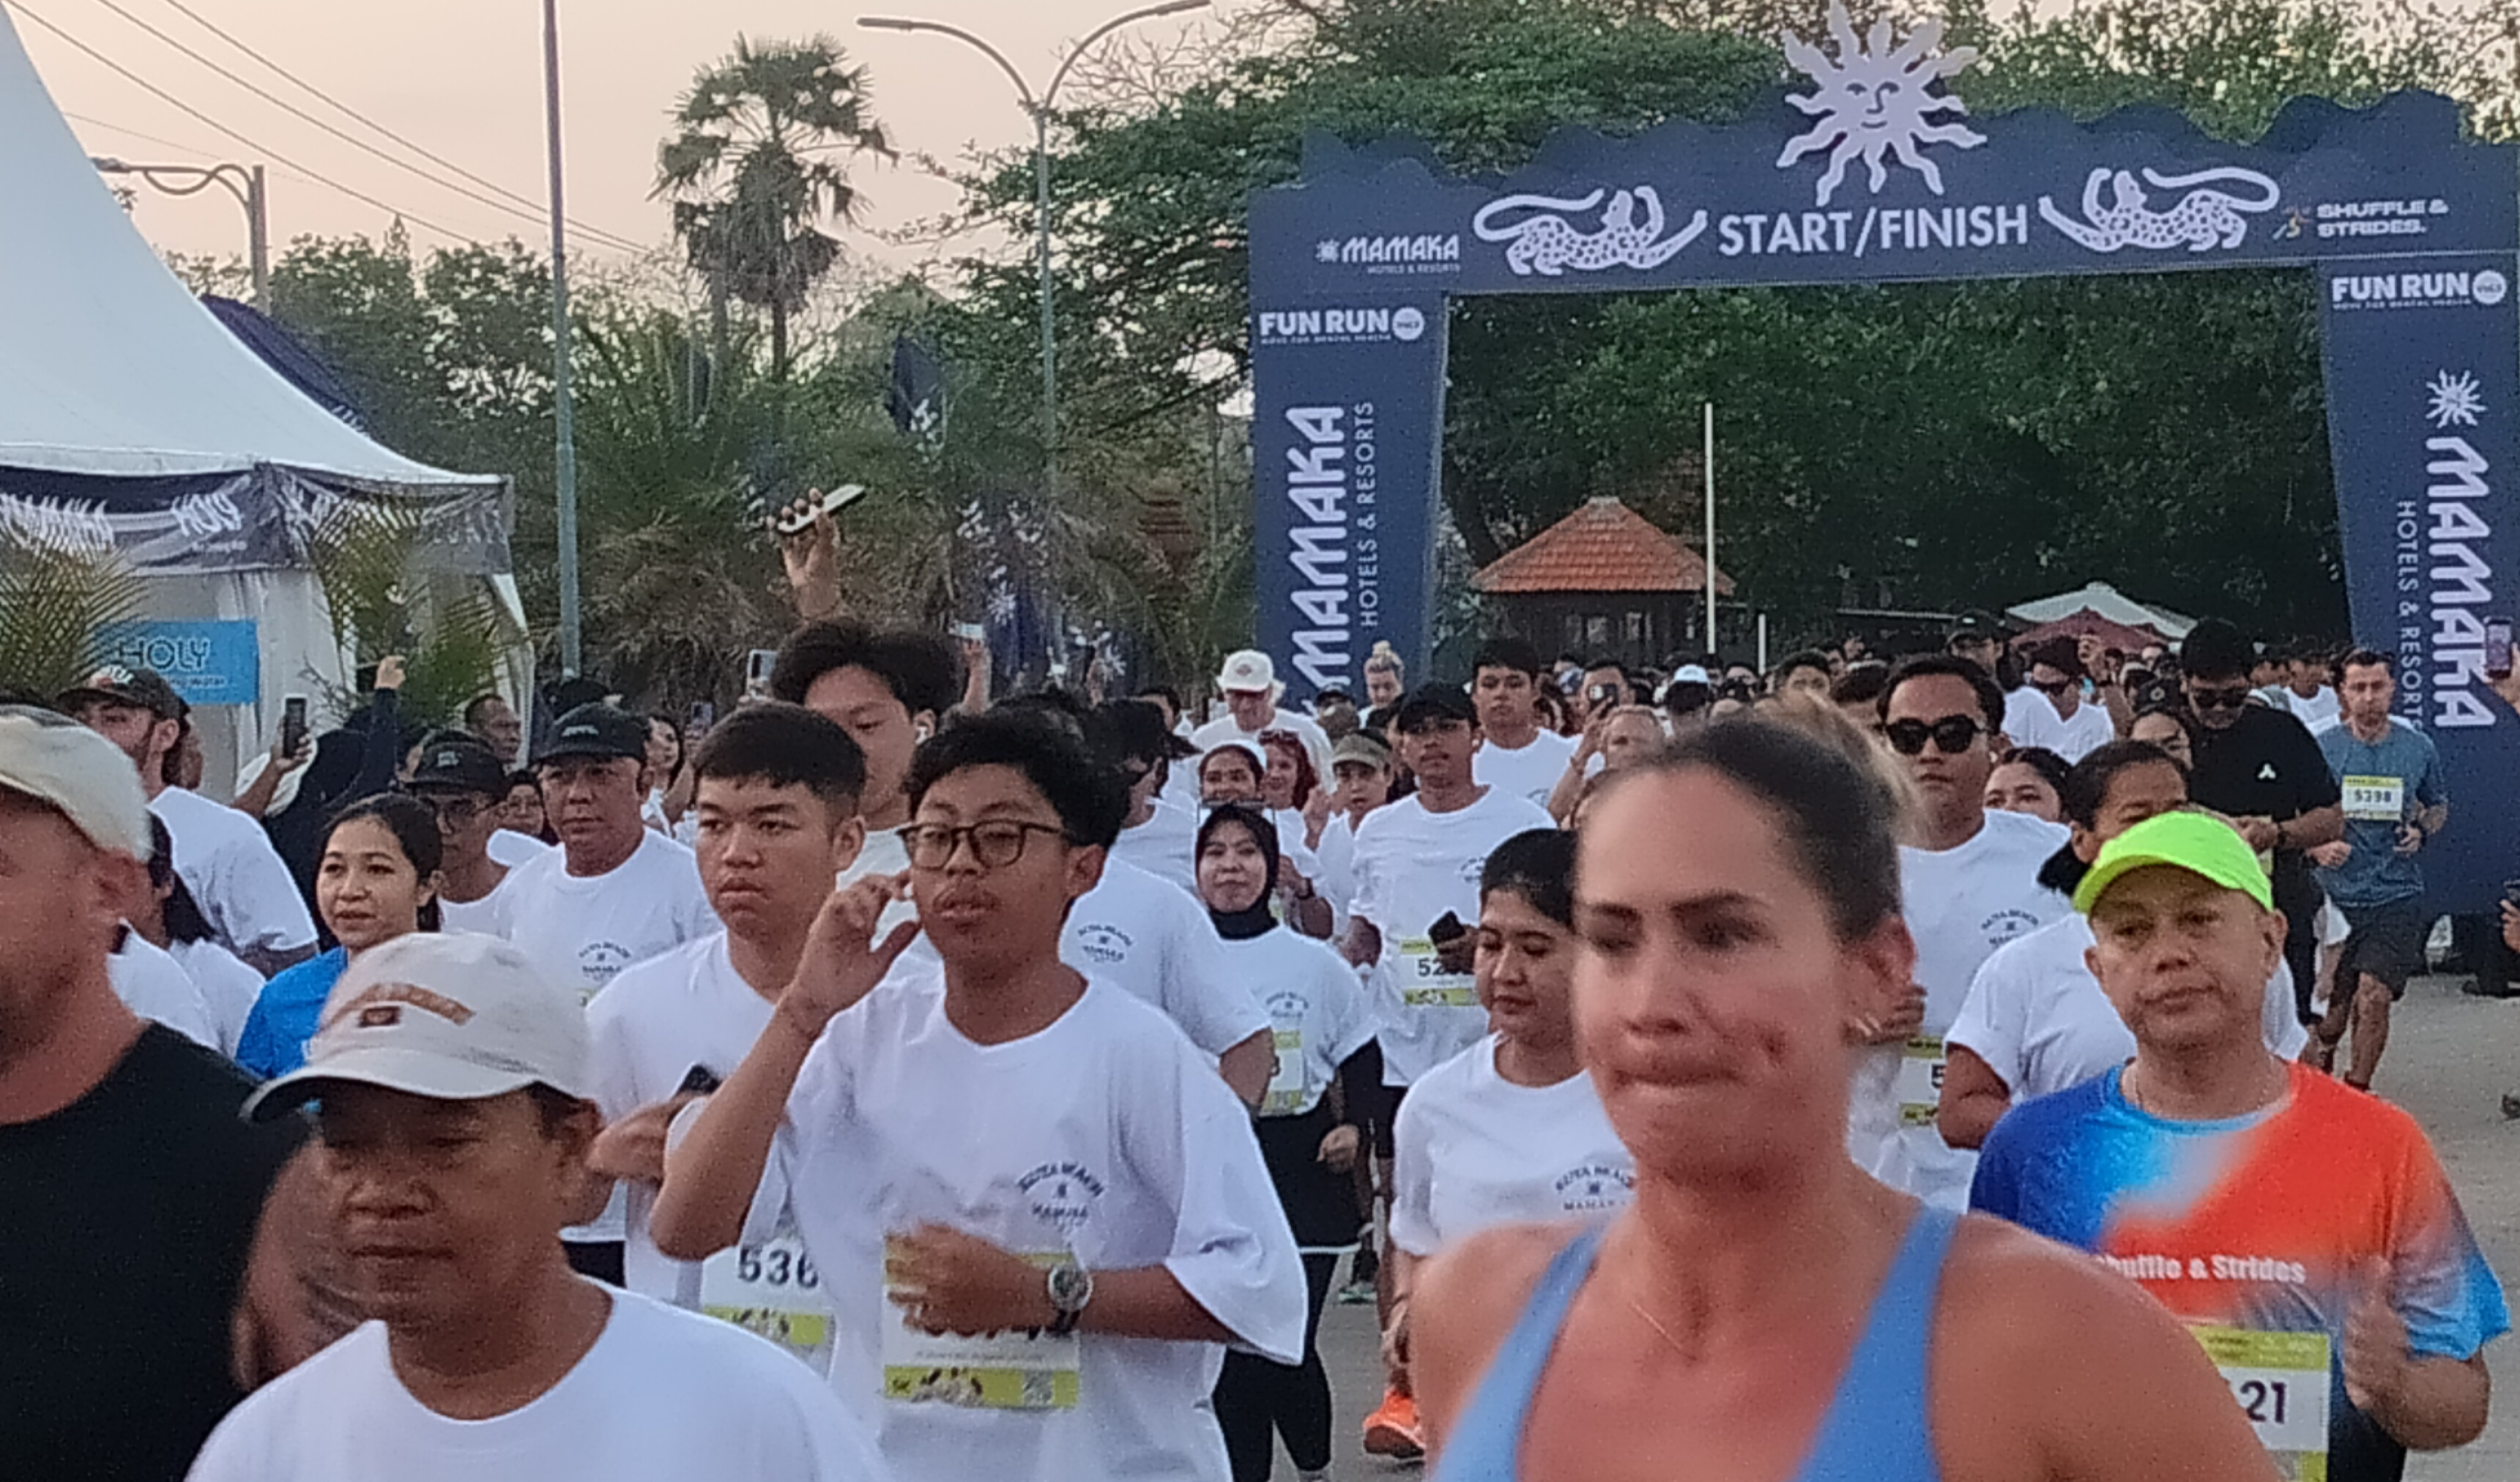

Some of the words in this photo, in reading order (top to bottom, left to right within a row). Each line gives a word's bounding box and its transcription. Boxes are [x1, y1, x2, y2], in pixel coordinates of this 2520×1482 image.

[2317, 199, 2425, 219] SHUFFLE
[2428, 199, 2448, 214] &
[1718, 204, 2028, 257] START/FINISH
[1342, 235, 1460, 263] MAMAKA
[2332, 275, 2396, 302] FUN
[2401, 272, 2469, 298] RUN
[1260, 310, 1320, 336] FUN
[1326, 308, 1389, 333] RUN
[1355, 401, 1376, 504] RESORTS
[1357, 513, 1377, 529] &
[1285, 406, 1351, 688] MAMAKA
[2396, 500, 2420, 592] HOTELS
[1357, 540, 1378, 628] HOTELS
[2426, 436, 2497, 727] MAMAKA
[2398, 601, 2420, 617] &
[118, 636, 210, 672] HOLY
[2100, 1254, 2182, 1281] huffle
[2190, 1257, 2209, 1280] &
[2211, 1254, 2306, 1284] Strides
[2240, 1379, 2287, 1425] 21
